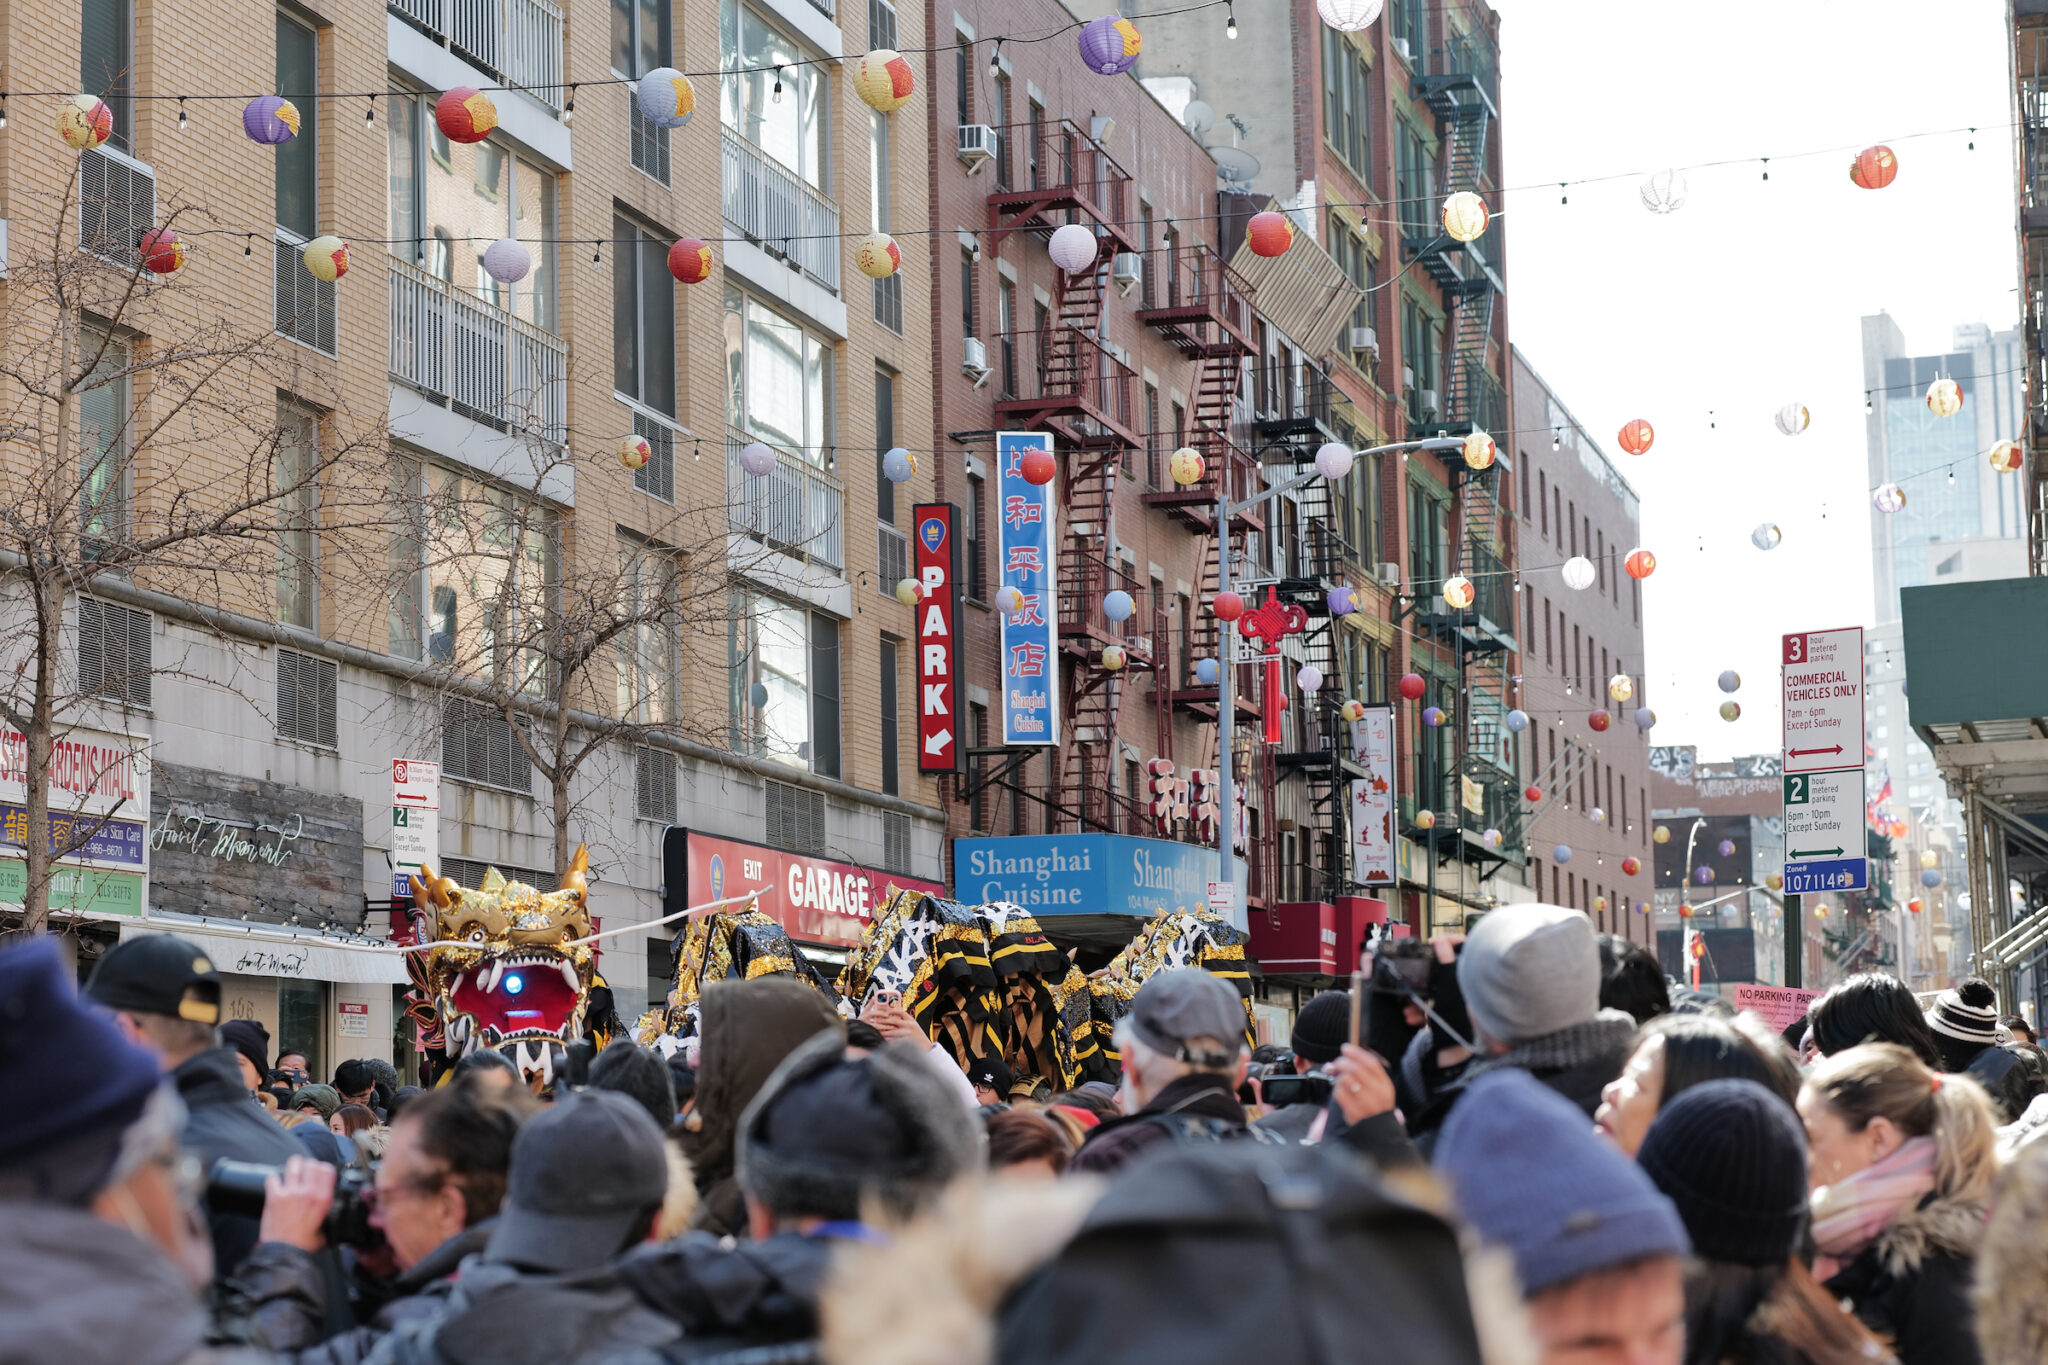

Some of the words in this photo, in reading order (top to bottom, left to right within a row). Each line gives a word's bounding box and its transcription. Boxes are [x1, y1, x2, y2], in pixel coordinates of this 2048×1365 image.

[921, 565, 949, 716] PARK
[1788, 636, 1802, 661] 3
[1810, 636, 1825, 644] hour
[1810, 643, 1838, 653] metered
[1810, 653, 1834, 664] parking
[1786, 671, 1847, 687] COMMERCIAL
[1787, 686, 1831, 702] VEHICLES
[1833, 684, 1857, 697] ONLY
[1011, 690, 1046, 714] Shanghai
[1787, 708, 1802, 718] 7am
[1809, 707, 1826, 717] 6pm
[1014, 713, 1044, 733] Cuisine
[1787, 720, 1812, 731] Except
[1814, 717, 1842, 729] Sunday
[48, 739, 98, 795] ARDENS
[101, 747, 134, 800] MALL
[1790, 777, 1803, 802] 2
[1812, 777, 1826, 785] hour
[1812, 785, 1839, 794] metered
[1812, 794, 1836, 804] parking
[397, 808, 405, 826] 2
[1788, 811, 1804, 822] 6pm
[1812, 808, 1831, 820] 10pm
[110, 825, 124, 840] Skin
[126, 826, 141, 842] Care
[1788, 823, 1812, 833] Except
[1814, 820, 1841, 832] Sunday
[75, 842, 123, 857] 2-966-6670
[743, 858, 763, 881] EXIT
[970, 847, 1092, 881] Shanghai
[1133, 847, 1201, 905] Shanghai
[1786, 864, 1808, 873] Zone#
[395, 882, 413, 894] 101
[1786, 872, 1835, 892] 107114
[788, 863, 870, 918] GARAGE
[981, 881, 1083, 905] Cuisine
[1127, 894, 1142, 909] 104
[1740, 989, 1753, 1000] NO
[1754, 990, 1792, 1003] PARKING
